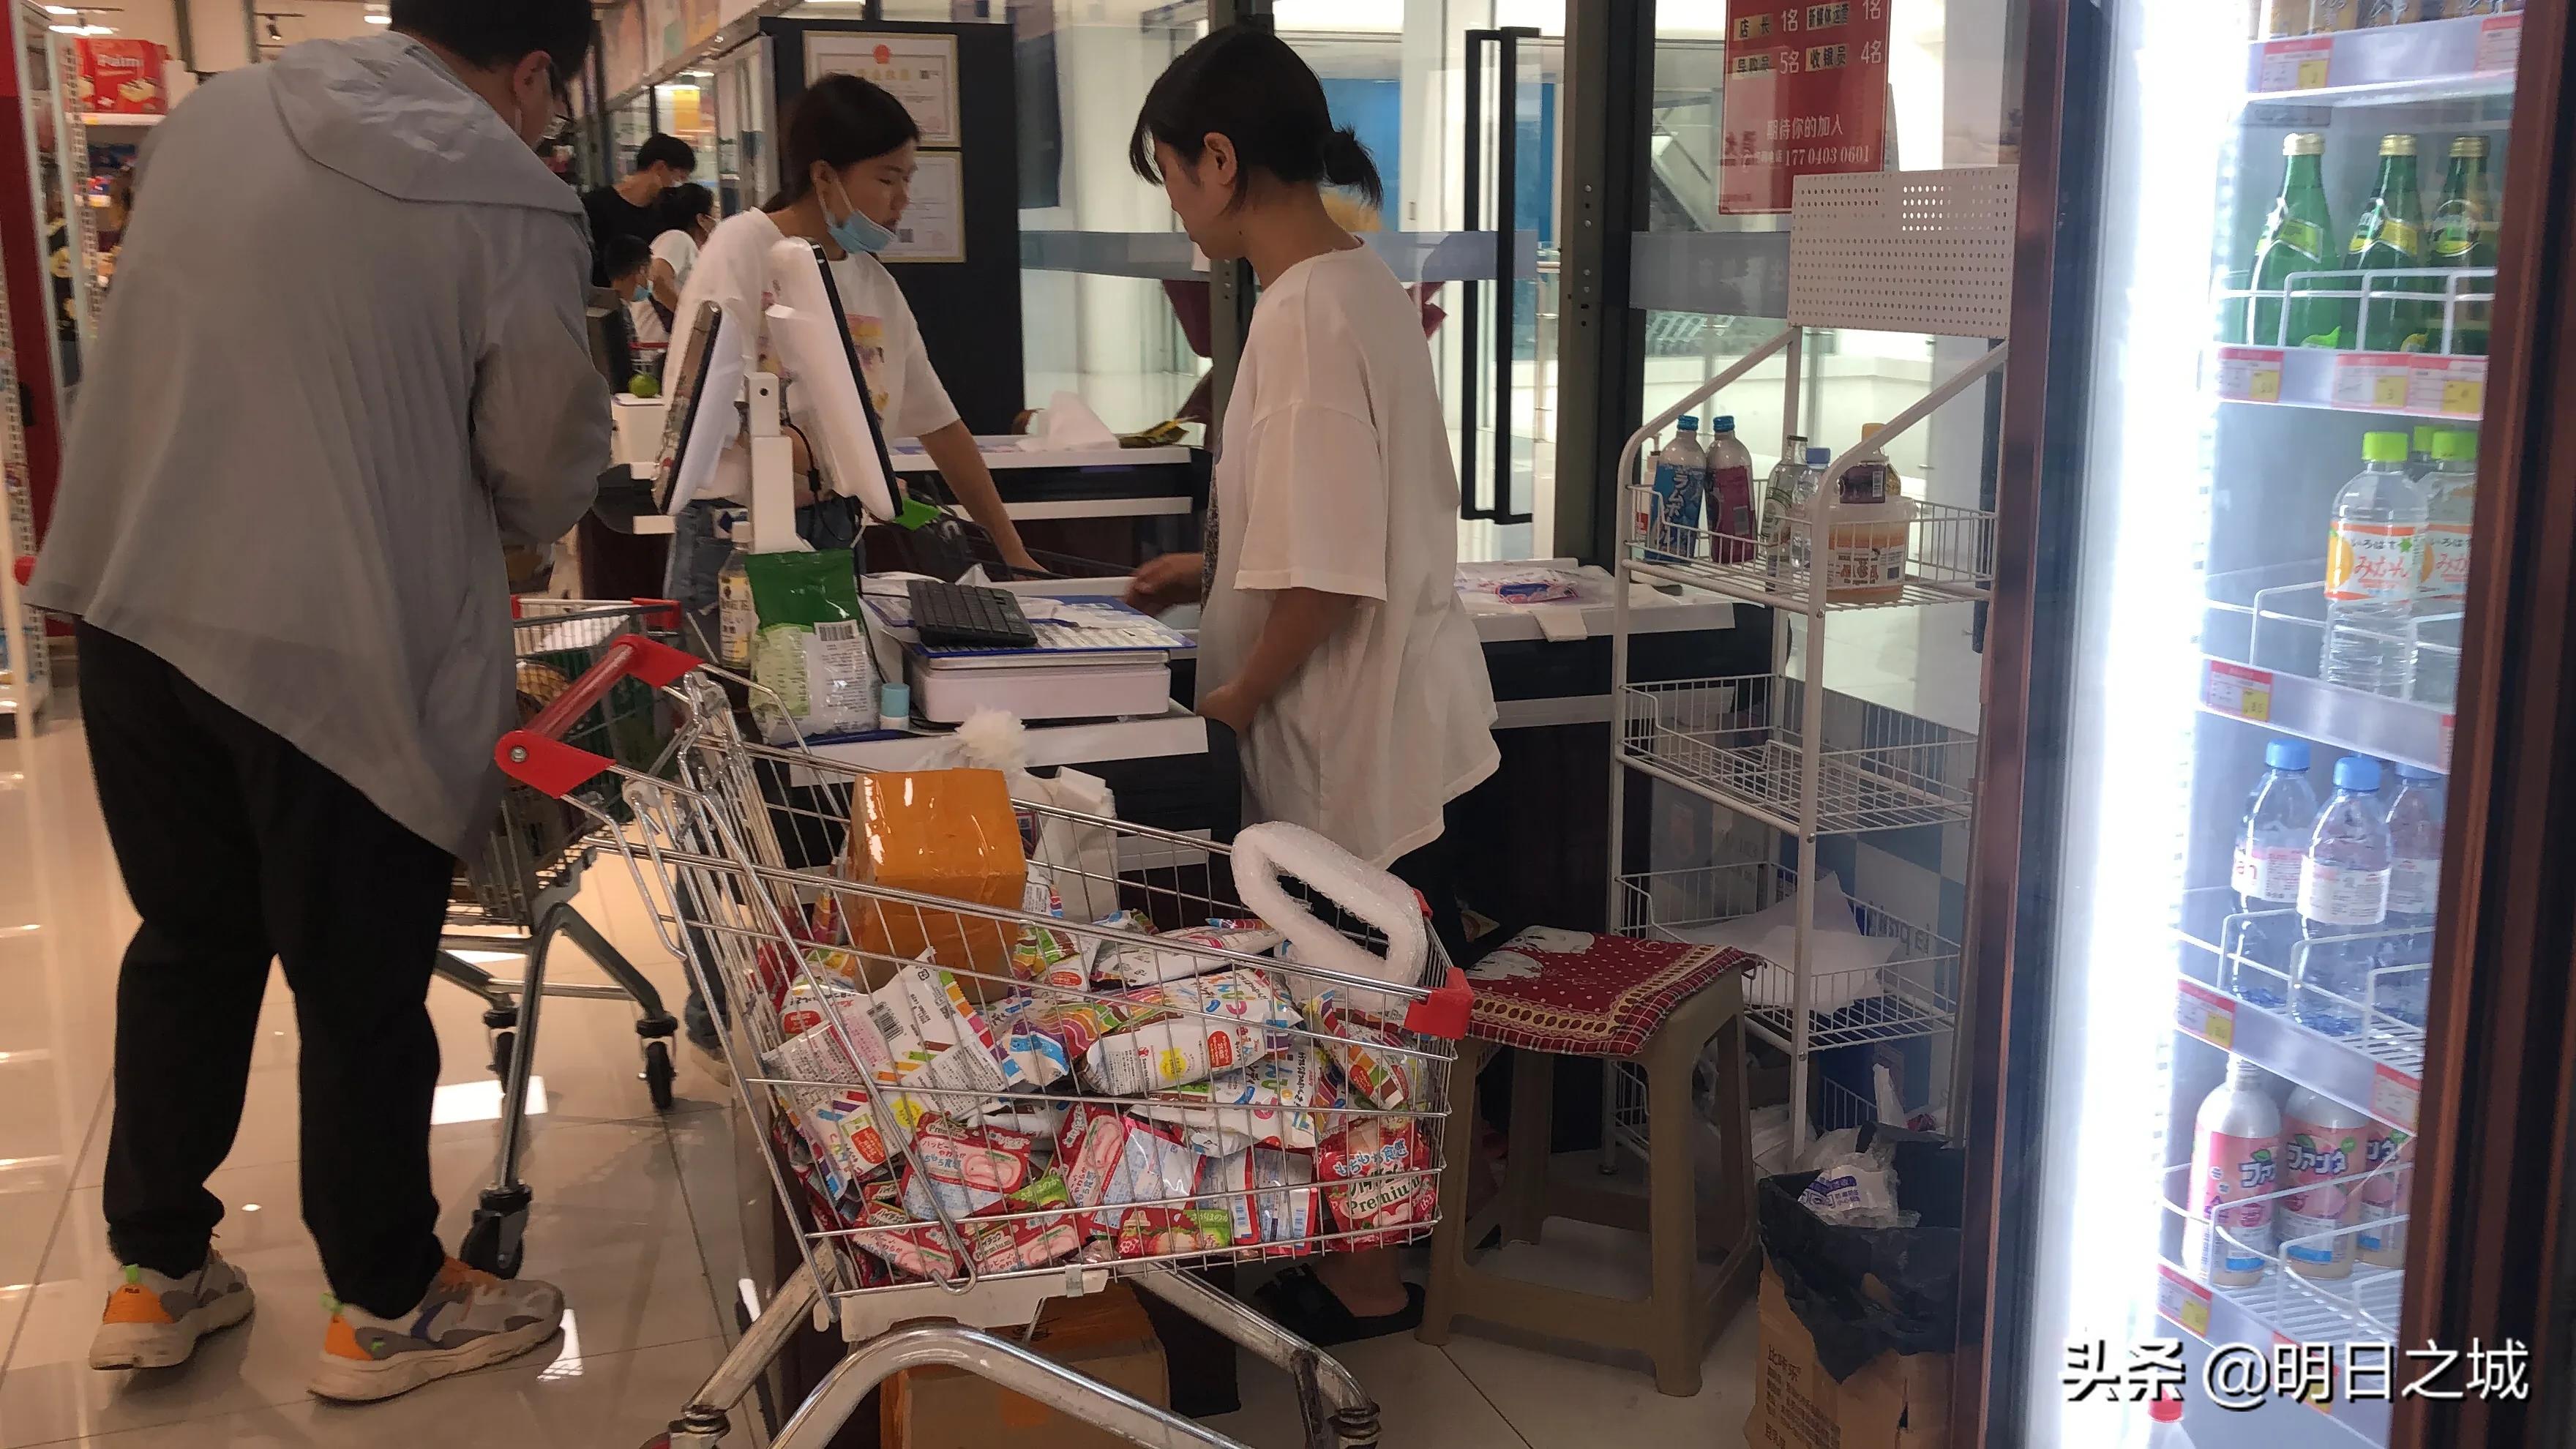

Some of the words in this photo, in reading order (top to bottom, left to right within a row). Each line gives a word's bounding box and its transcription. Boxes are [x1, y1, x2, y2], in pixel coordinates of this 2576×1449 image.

[1780, 50, 1800, 74] 5名
[1811, 46, 1846, 69] 收银员
[1861, 40, 1882, 64] 4名
[1808, 147, 1837, 165] 0403
[1840, 145, 1869, 163] 0601
[2288, 1142, 2346, 1175] ファンタ
[1347, 1175, 1421, 1215] Premium
